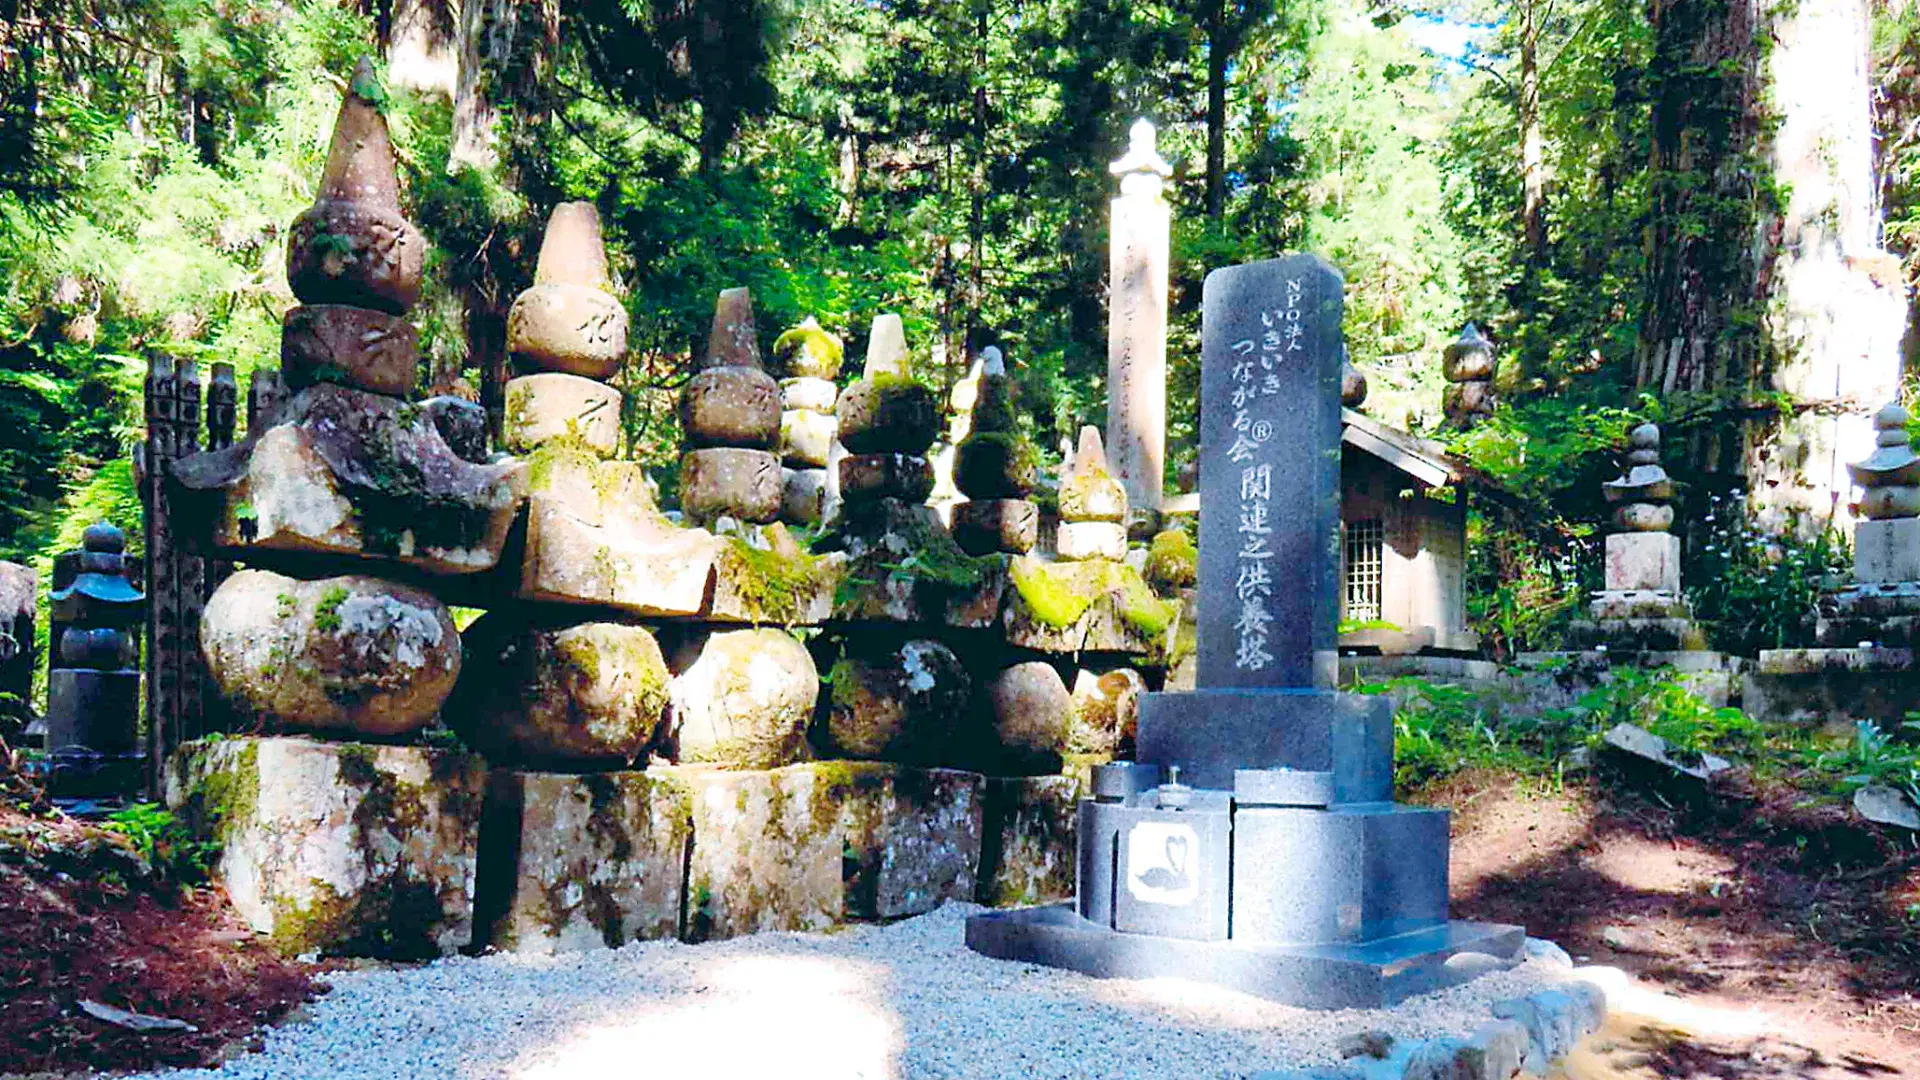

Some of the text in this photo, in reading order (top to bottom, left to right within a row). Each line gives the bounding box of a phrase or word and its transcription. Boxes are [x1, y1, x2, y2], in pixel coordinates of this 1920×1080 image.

[1261, 310, 1283, 394] いきいき
[1286, 277, 1303, 352] NPO法人
